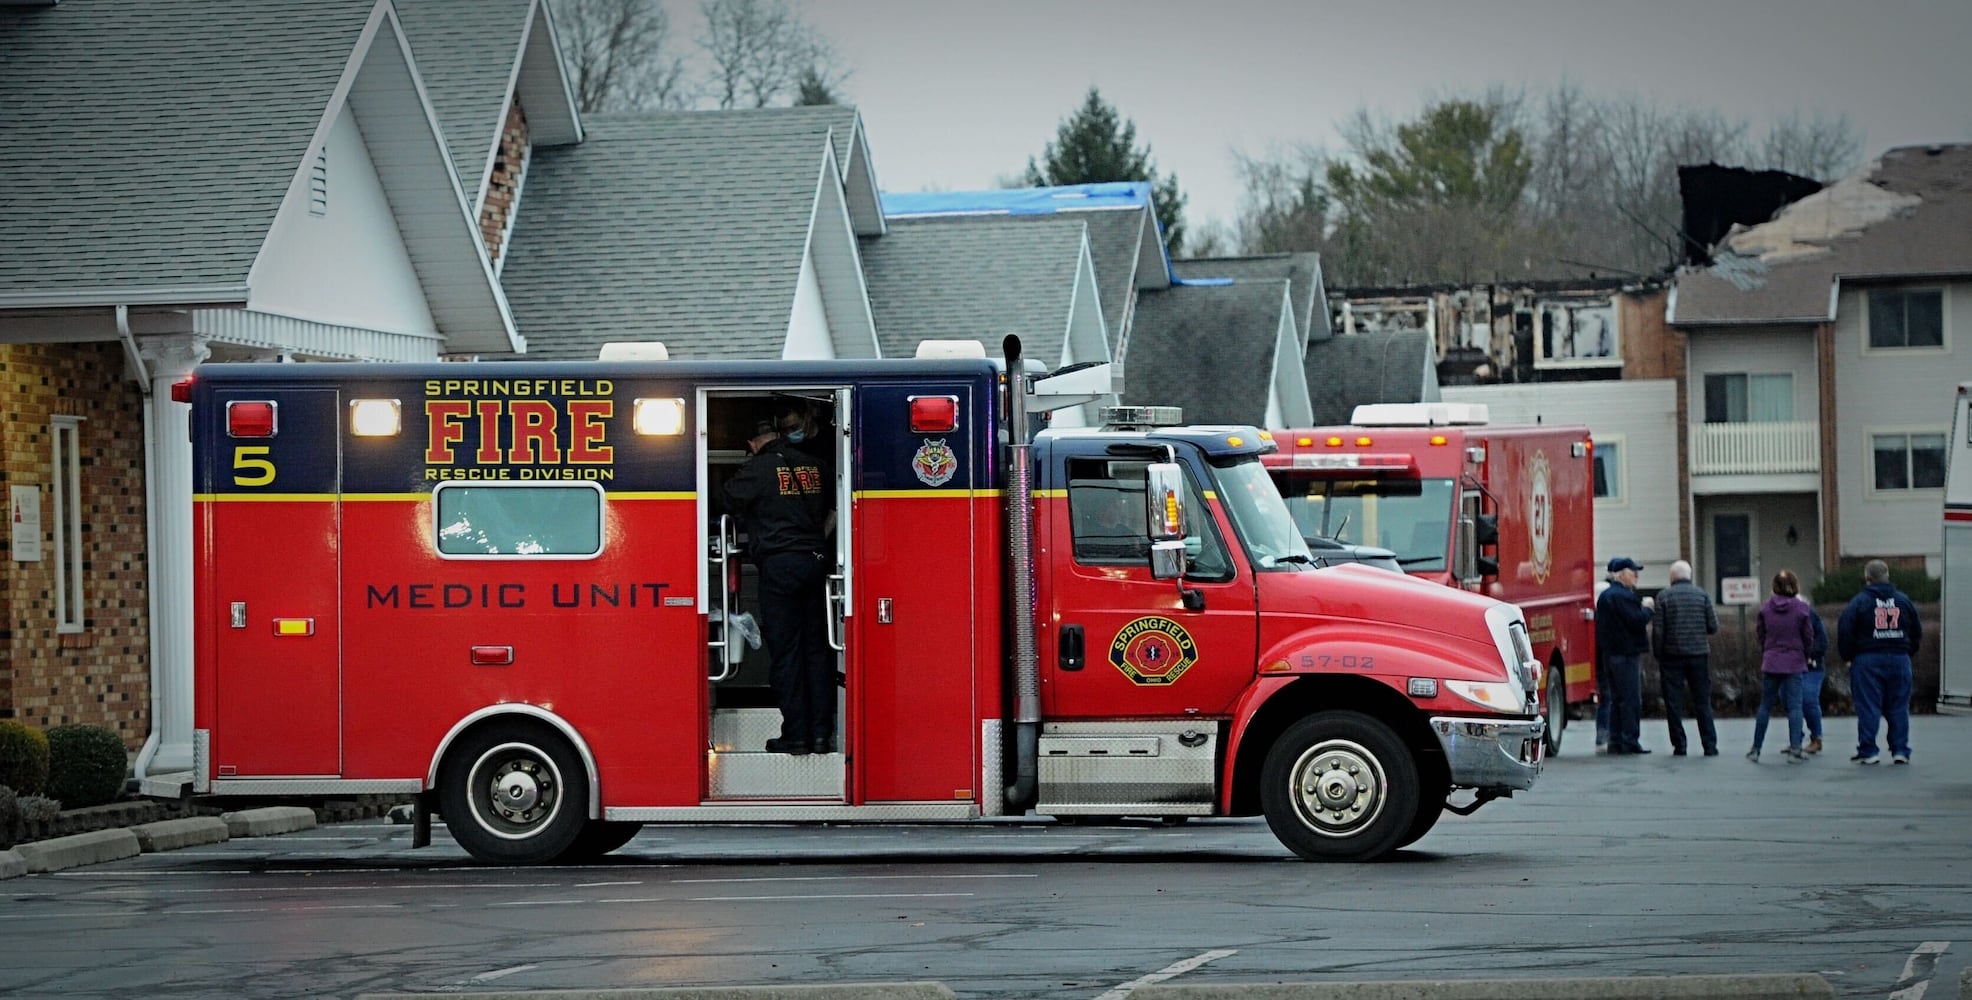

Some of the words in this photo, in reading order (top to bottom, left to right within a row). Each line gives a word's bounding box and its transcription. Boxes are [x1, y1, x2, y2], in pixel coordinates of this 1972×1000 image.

[425, 380, 614, 396] SPRINGFIELD
[425, 400, 614, 464] FIRE
[233, 446, 276, 486] 5
[425, 468, 511, 480] RESCUE
[519, 468, 614, 480] DIVISION
[1534, 494, 1546, 537] 27
[366, 583, 526, 608] MEDIC
[552, 583, 670, 608] UNIT
[1874, 607, 1900, 629] 27
[1114, 618, 1192, 651] SPRINGFIELD
[1120, 662, 1137, 679] FIRE
[1166, 656, 1192, 682] RESCUE
[1301, 655, 1374, 669] 57-02
